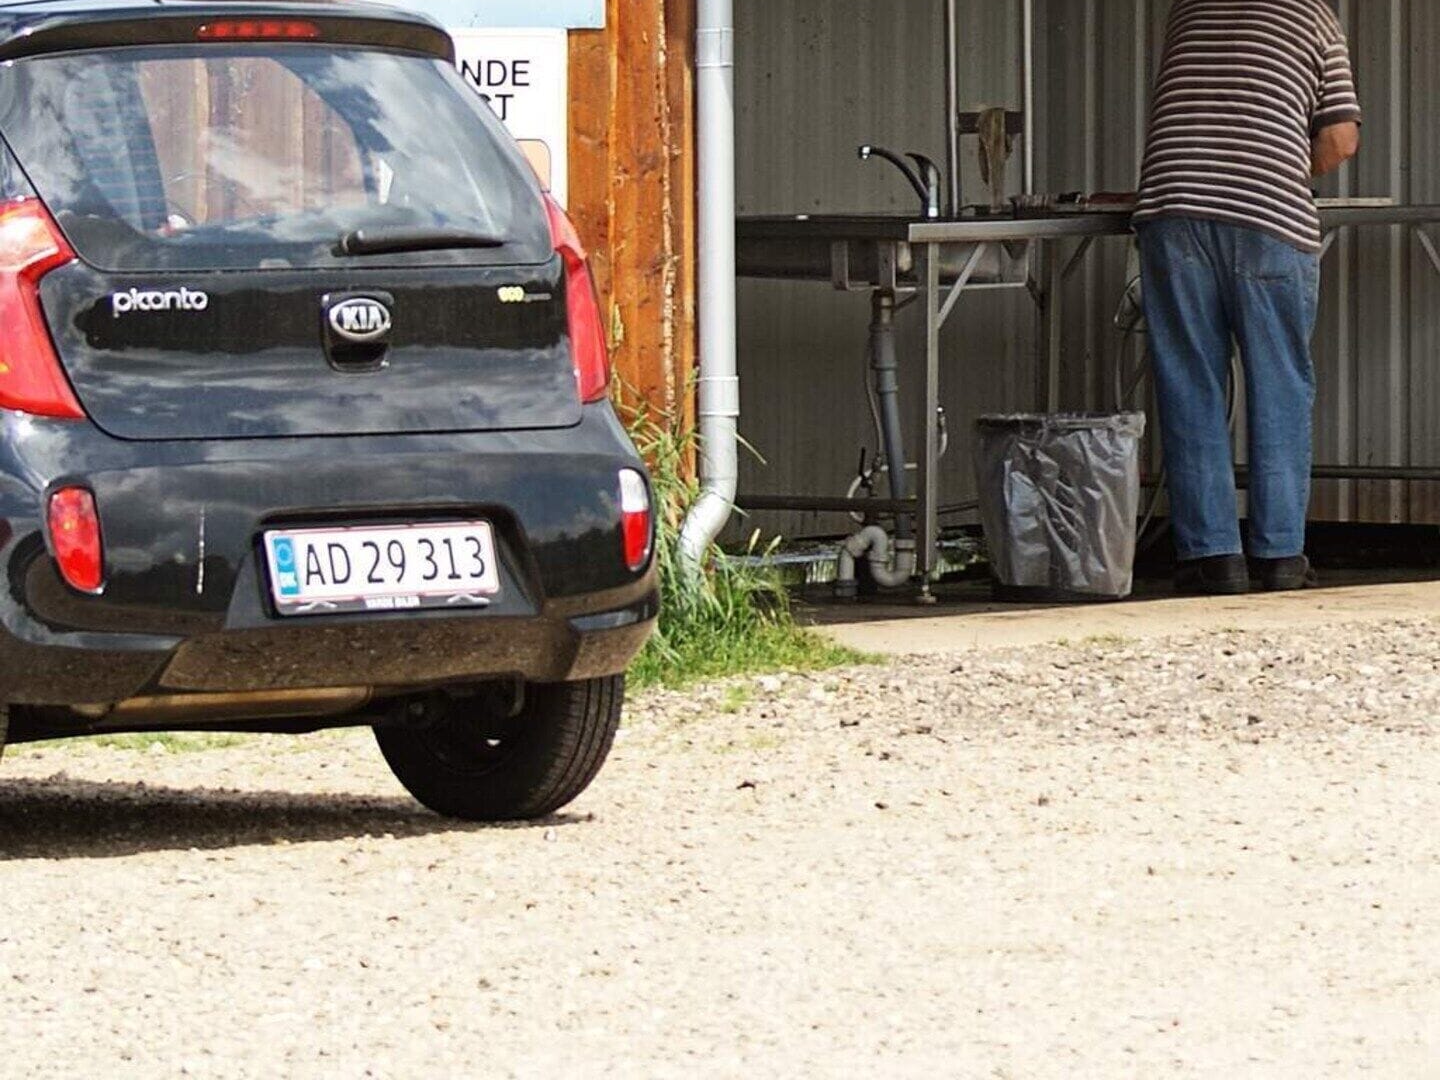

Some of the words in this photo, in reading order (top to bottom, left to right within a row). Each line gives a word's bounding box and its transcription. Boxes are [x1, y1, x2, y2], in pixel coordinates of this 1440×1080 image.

[461, 59, 530, 87] NDE
[112, 286, 208, 318] picanto
[342, 306, 382, 330] KIA
[305, 542, 352, 586] AD
[362, 539, 407, 584] 29
[418, 536, 485, 581] 313
